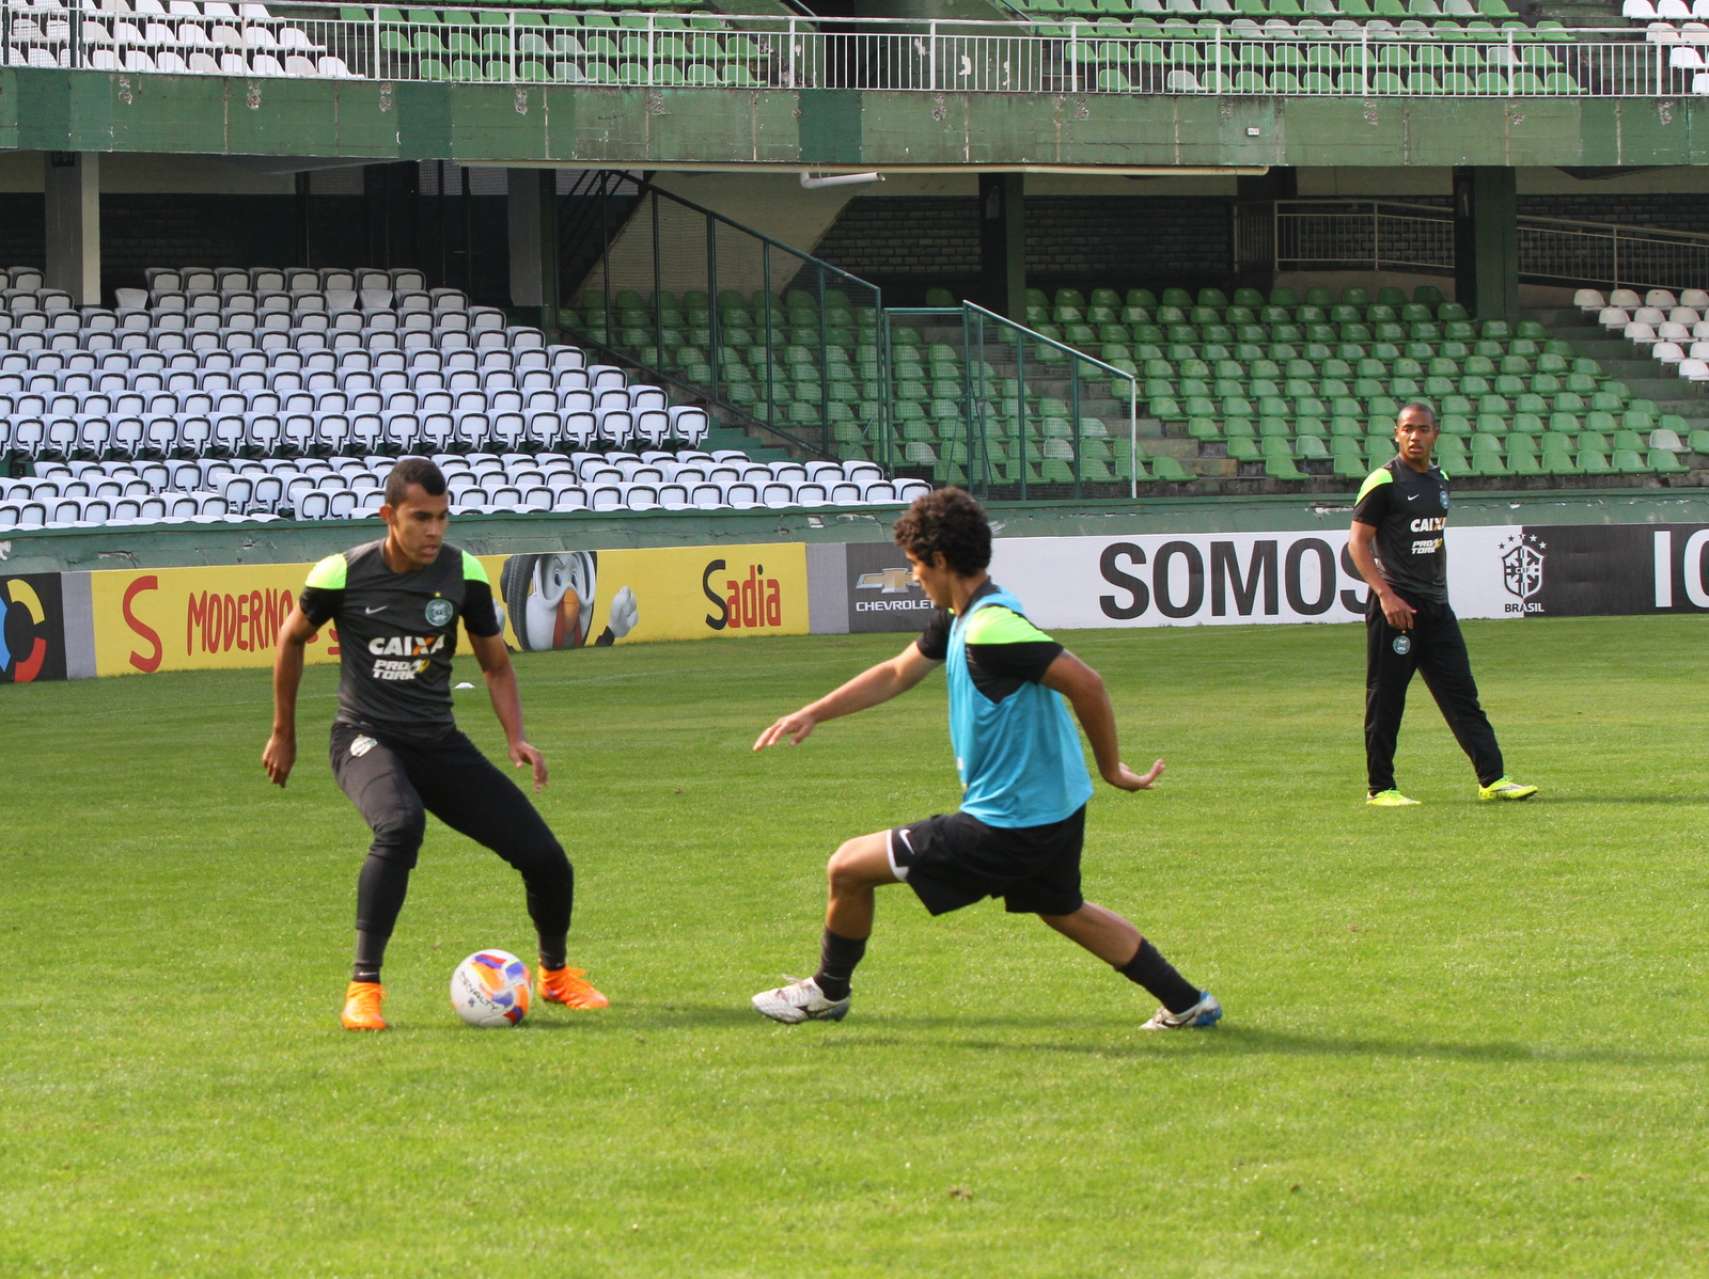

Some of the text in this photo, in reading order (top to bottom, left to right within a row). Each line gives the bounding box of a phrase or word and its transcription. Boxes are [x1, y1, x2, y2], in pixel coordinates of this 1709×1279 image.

[703, 559, 781, 630] Sadia
[856, 599, 934, 612] CHEVROLET
[1505, 602, 1545, 612] BRASIL
[123, 575, 162, 673] S
[368, 634, 445, 656] CAIXA
